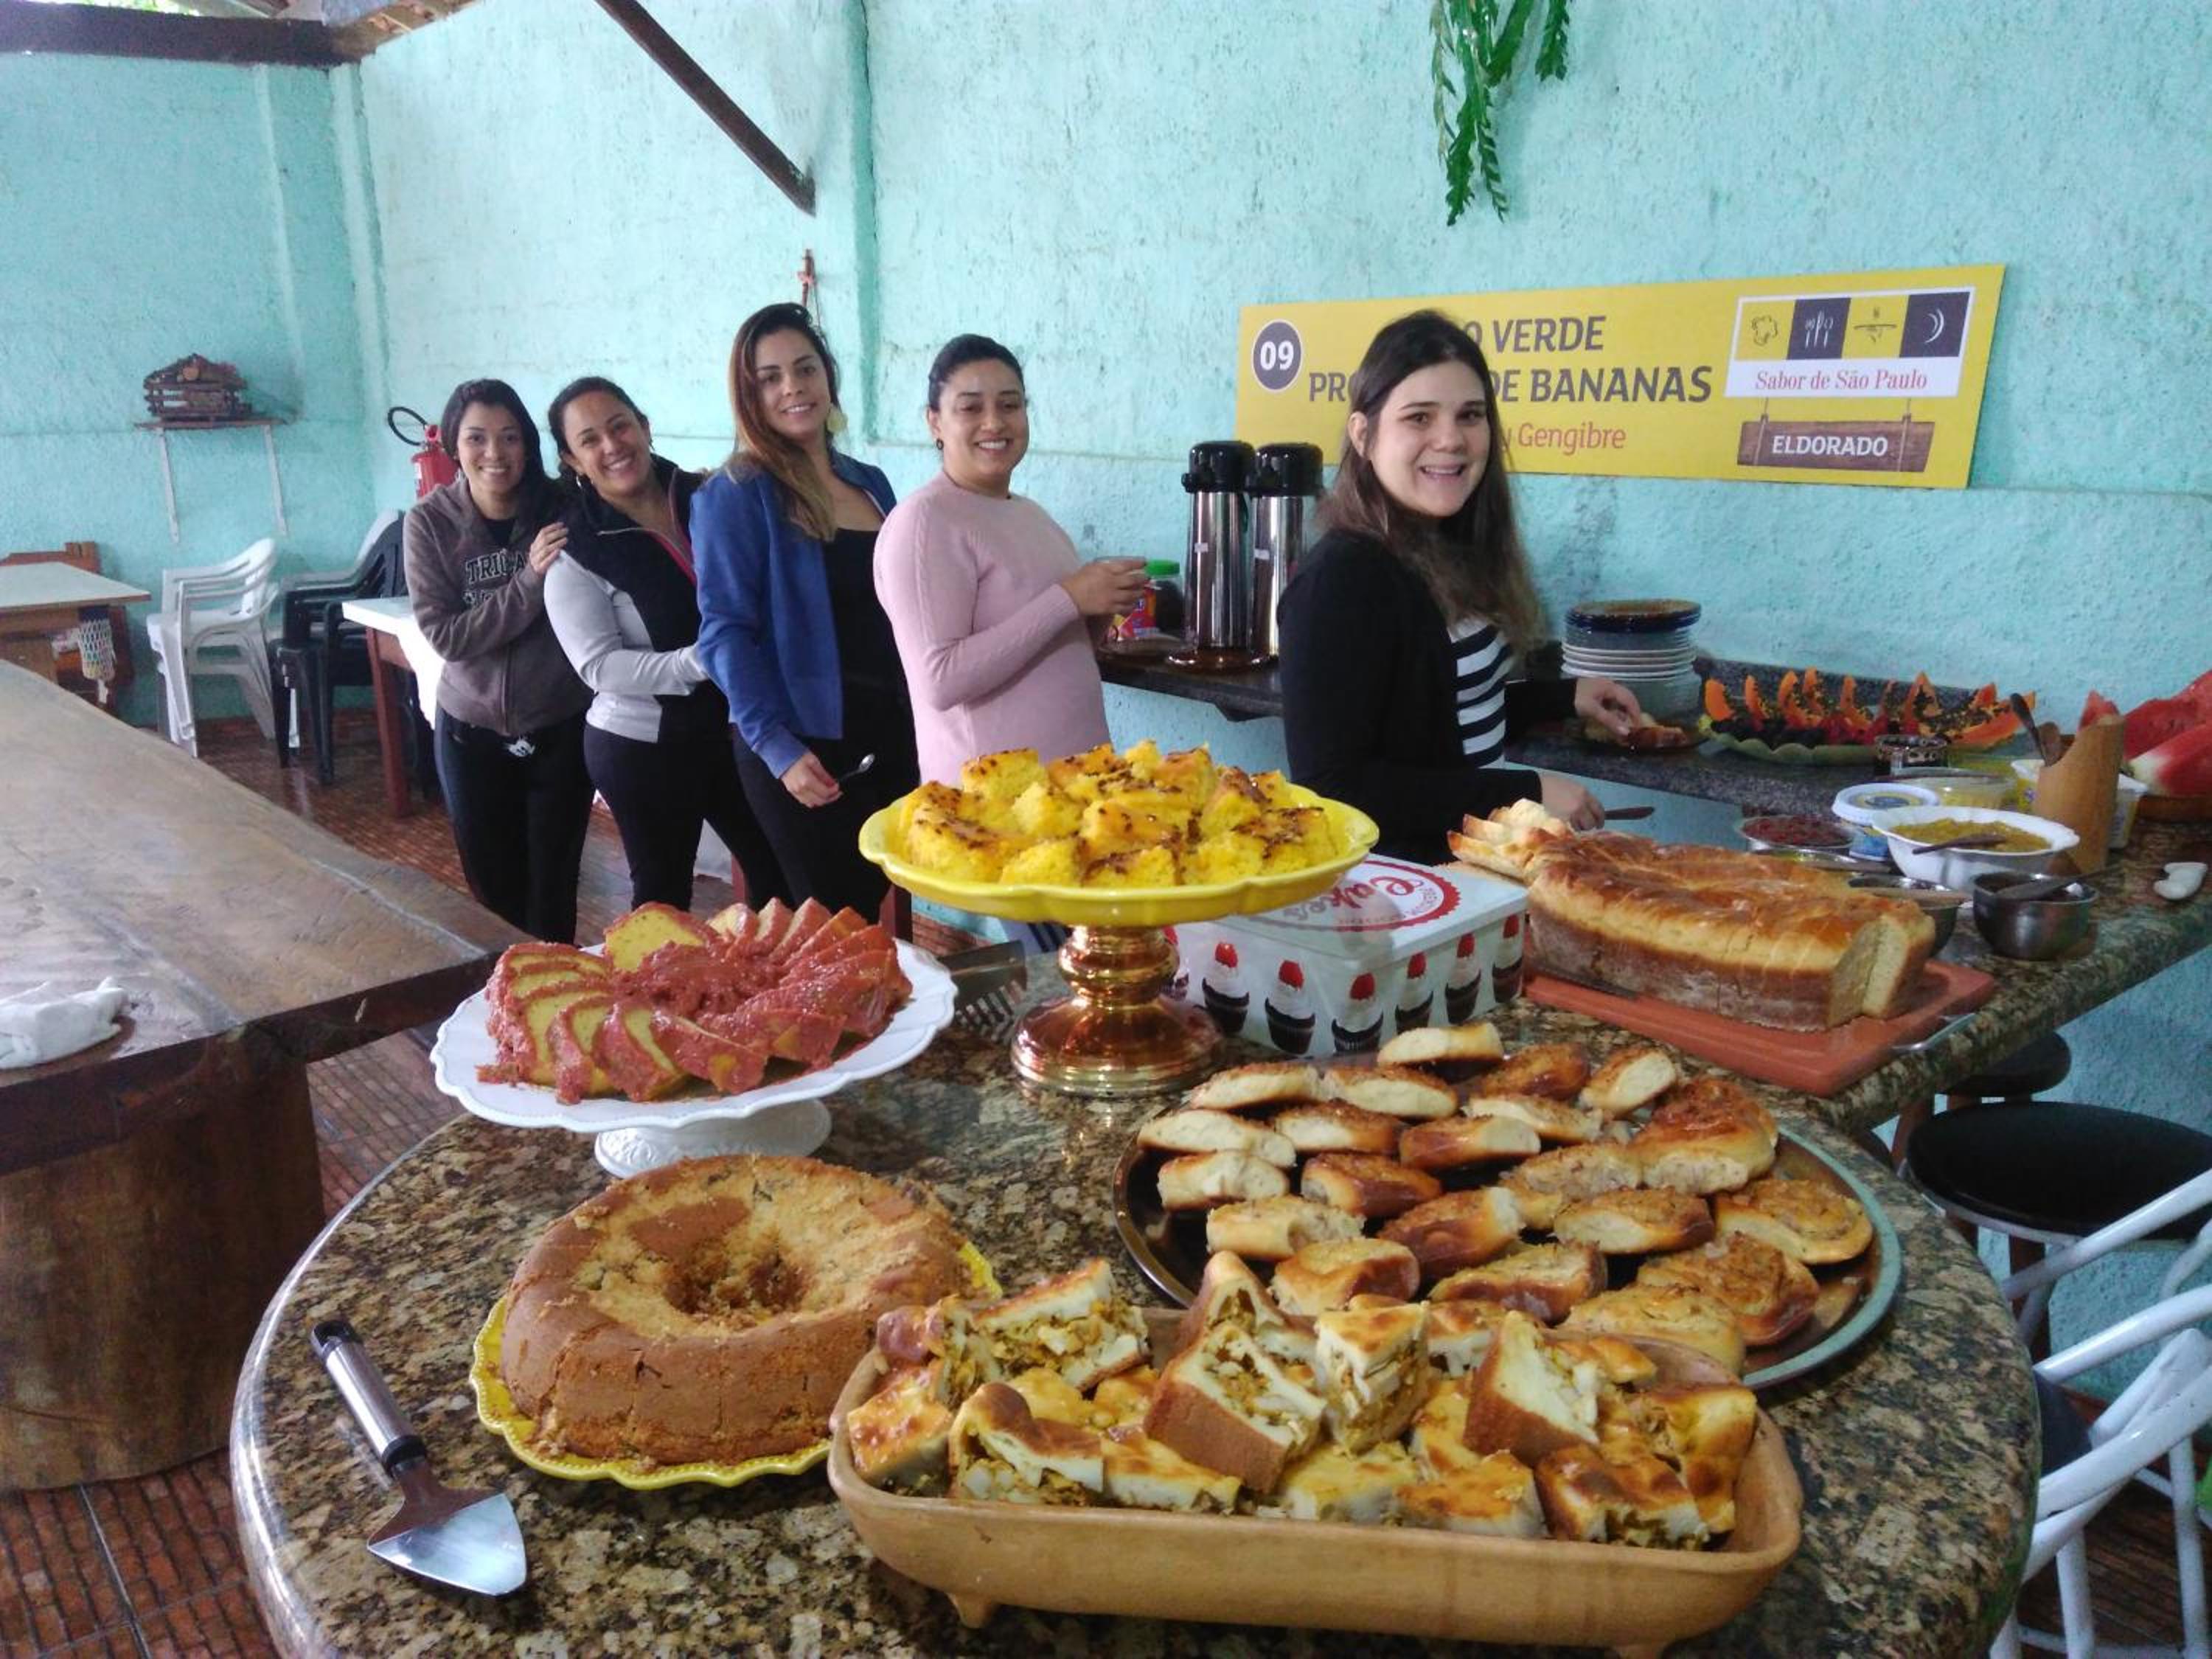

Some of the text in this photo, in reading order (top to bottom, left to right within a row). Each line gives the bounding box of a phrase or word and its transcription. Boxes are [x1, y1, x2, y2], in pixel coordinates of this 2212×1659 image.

[1492, 316, 1606, 353] VERDE
[1259, 341, 1294, 370] 09
[1529, 365, 1713, 403] BANANAS
[1755, 368, 1927, 391] Sabor de São Paulo
[1517, 421, 1627, 456] Gengibre
[1771, 434, 1889, 457] ELDORADO
